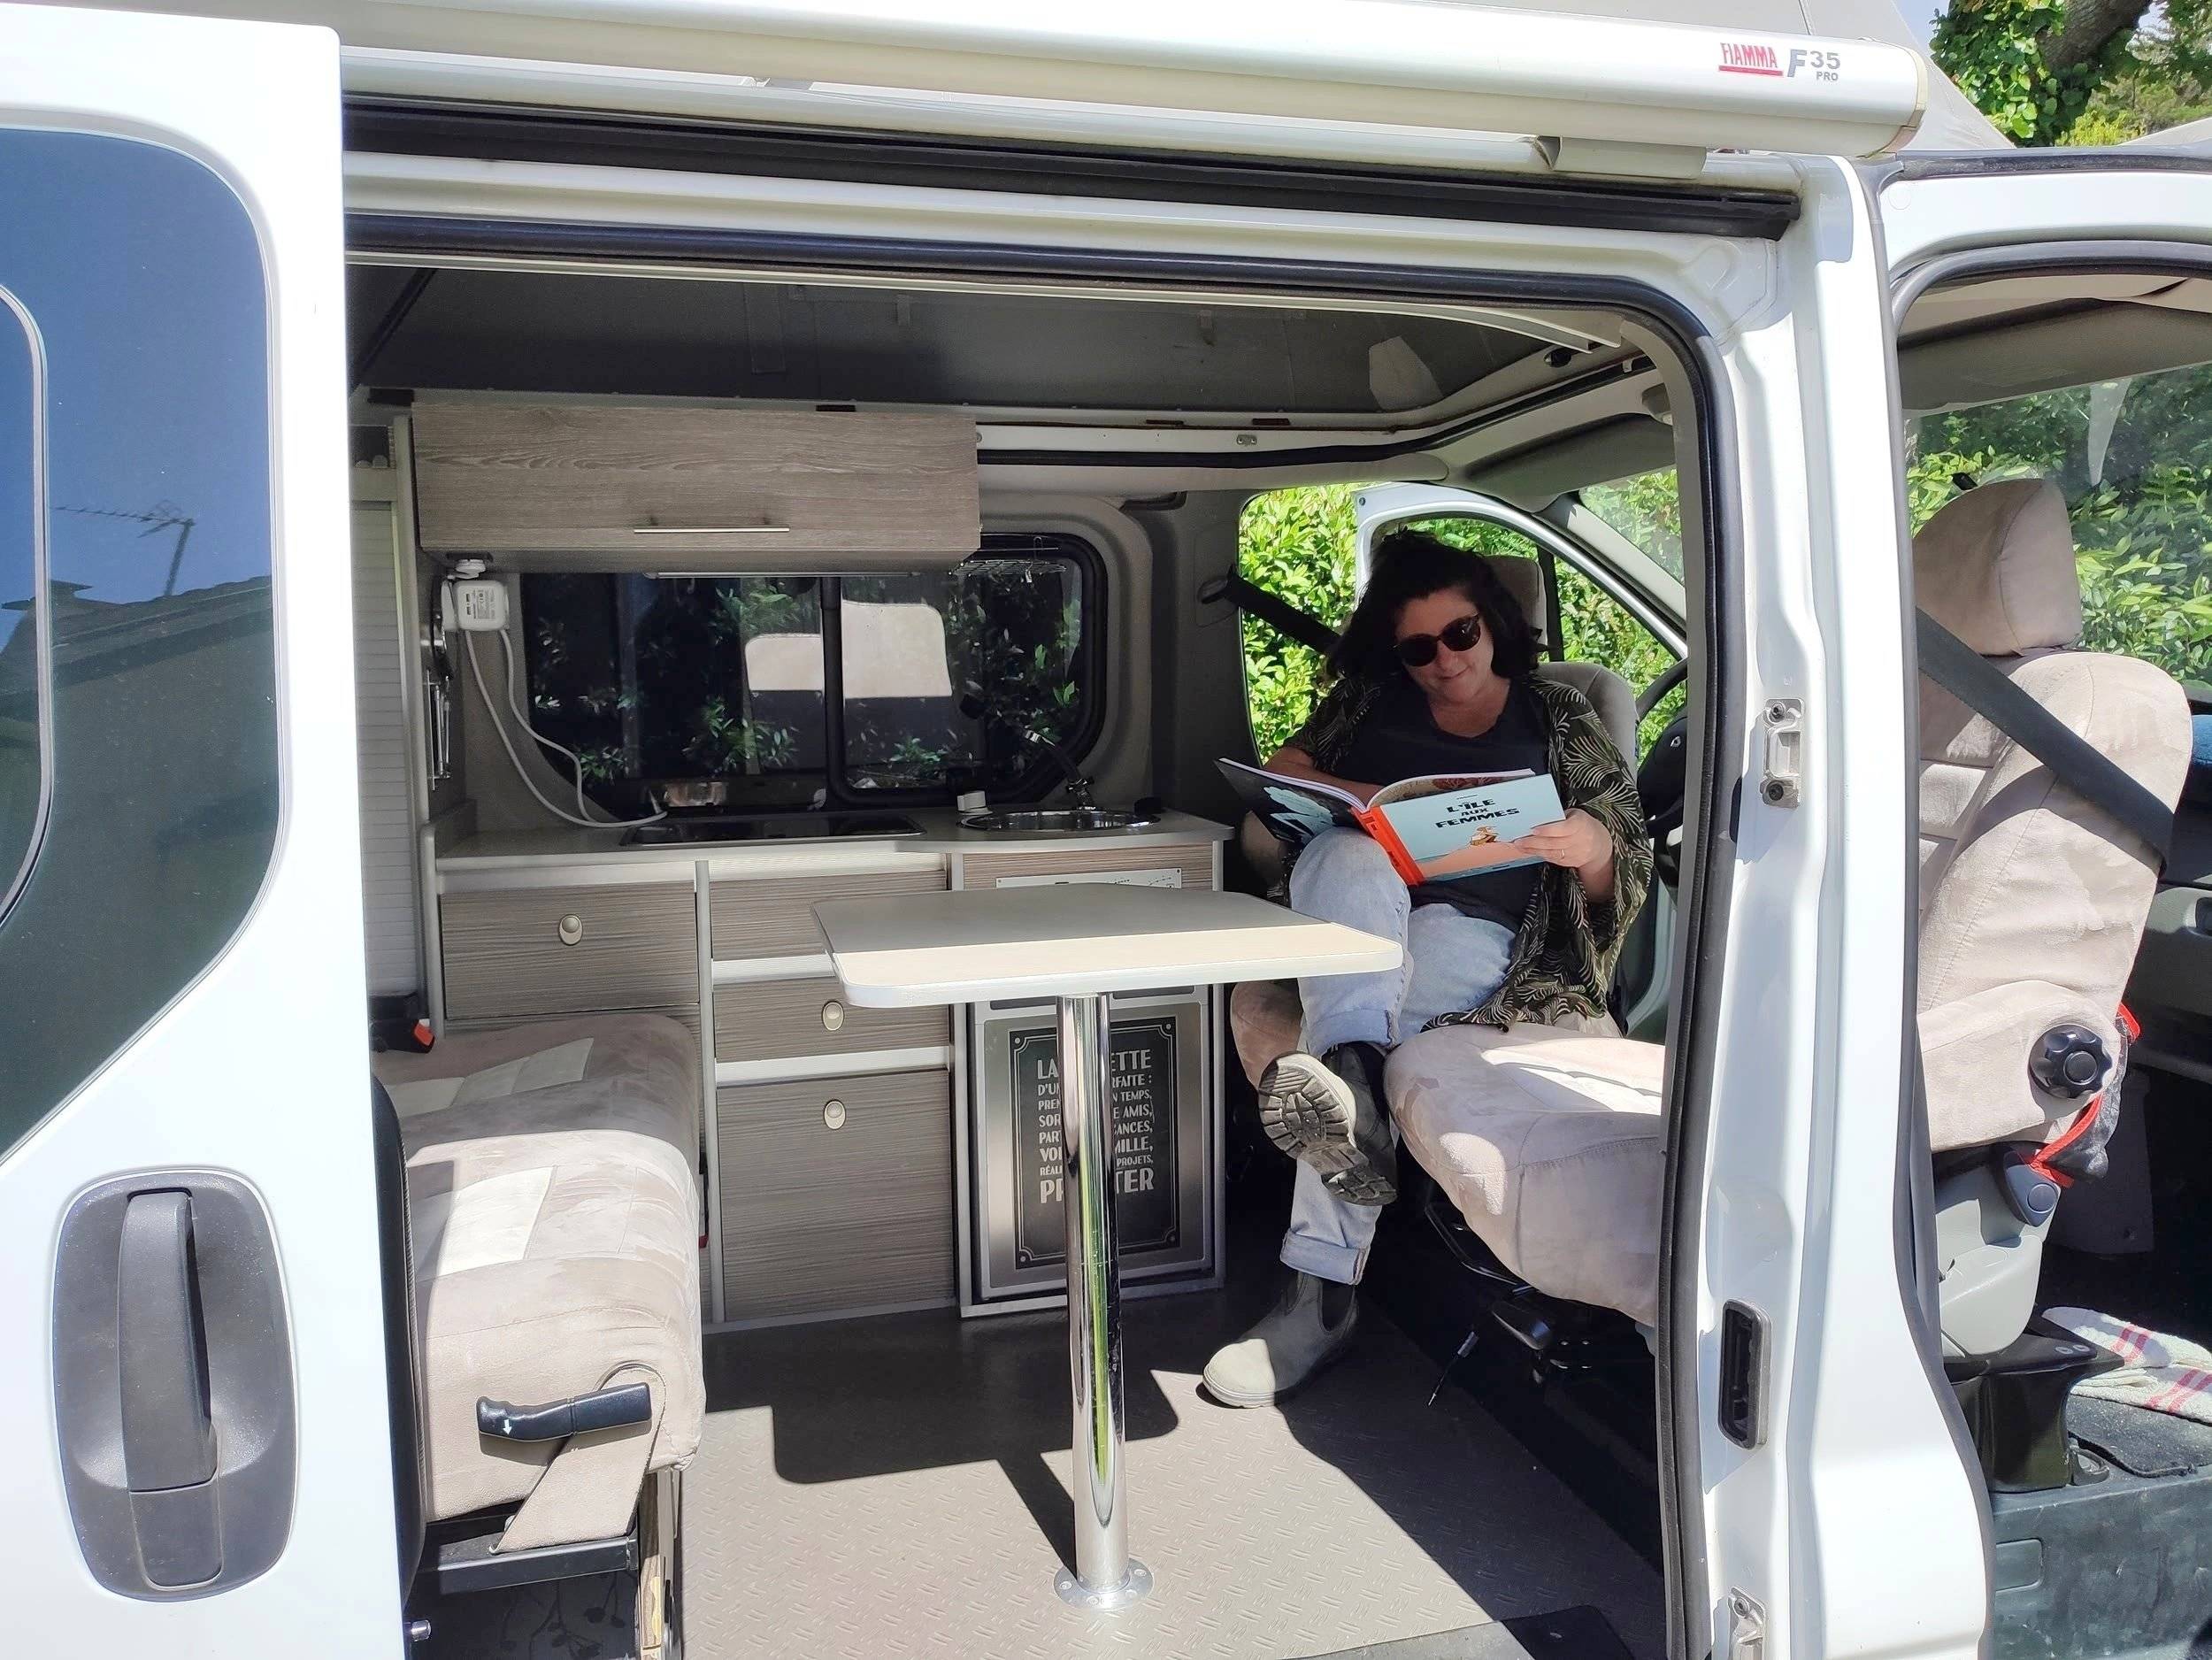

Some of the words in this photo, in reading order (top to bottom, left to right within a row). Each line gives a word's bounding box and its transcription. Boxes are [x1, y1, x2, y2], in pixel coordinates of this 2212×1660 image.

[1719, 42, 1778, 68] FIAMMA
[1816, 72, 1839, 81] PRO
[1435, 808, 1520, 828] FEMMES
[1037, 1058, 1059, 1079] LA
[1039, 1113, 1062, 1127] SOR
[1123, 1103, 1153, 1118] AMIS,
[1114, 1119, 1153, 1135] ANCES,
[1117, 1154, 1154, 1167] PROJETS,
